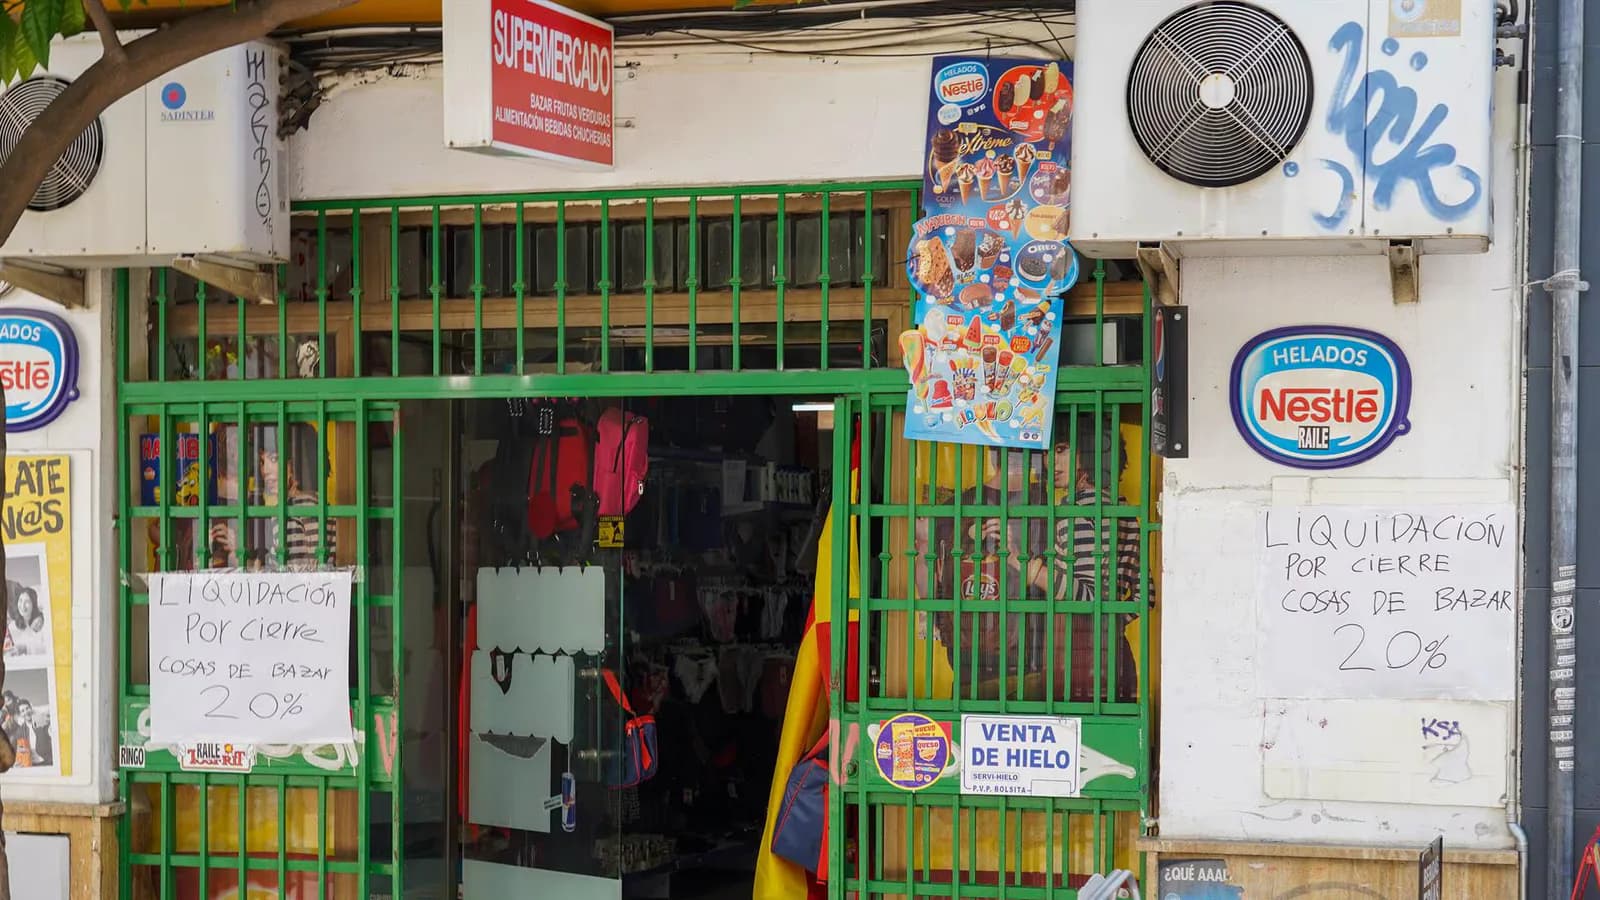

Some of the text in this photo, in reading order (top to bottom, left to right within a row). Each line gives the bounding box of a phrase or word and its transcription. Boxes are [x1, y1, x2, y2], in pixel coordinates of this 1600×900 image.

[494, 9, 611, 96] SUPERMERCADO
[943, 65, 977, 78] HELADOS
[160, 111, 215, 121] SADINTER
[530, 93, 610, 128] BAZAR FRUTAS VERDURAS
[544, 118, 572, 139] BEBIDAS
[1273, 346, 1368, 367] HELADOS
[1299, 427, 1328, 449] RAILE
[1285, 552, 1327, 580] POR
[1281, 587, 1513, 615] COSAS DE BAZAR
[1333, 623, 1449, 675] 20%
[158, 656, 216, 676] COSAS
[229, 663, 253, 679] DE
[200, 685, 303, 719] 20%
[981, 723, 1056, 744] VENTA
[121, 747, 144, 765] RINGO
[197, 743, 220, 758] RAILE
[972, 747, 1070, 769] DE HIELO
[994, 785, 1026, 794] BOLSITA
[1164, 864, 1195, 881] ¿QUÉ
